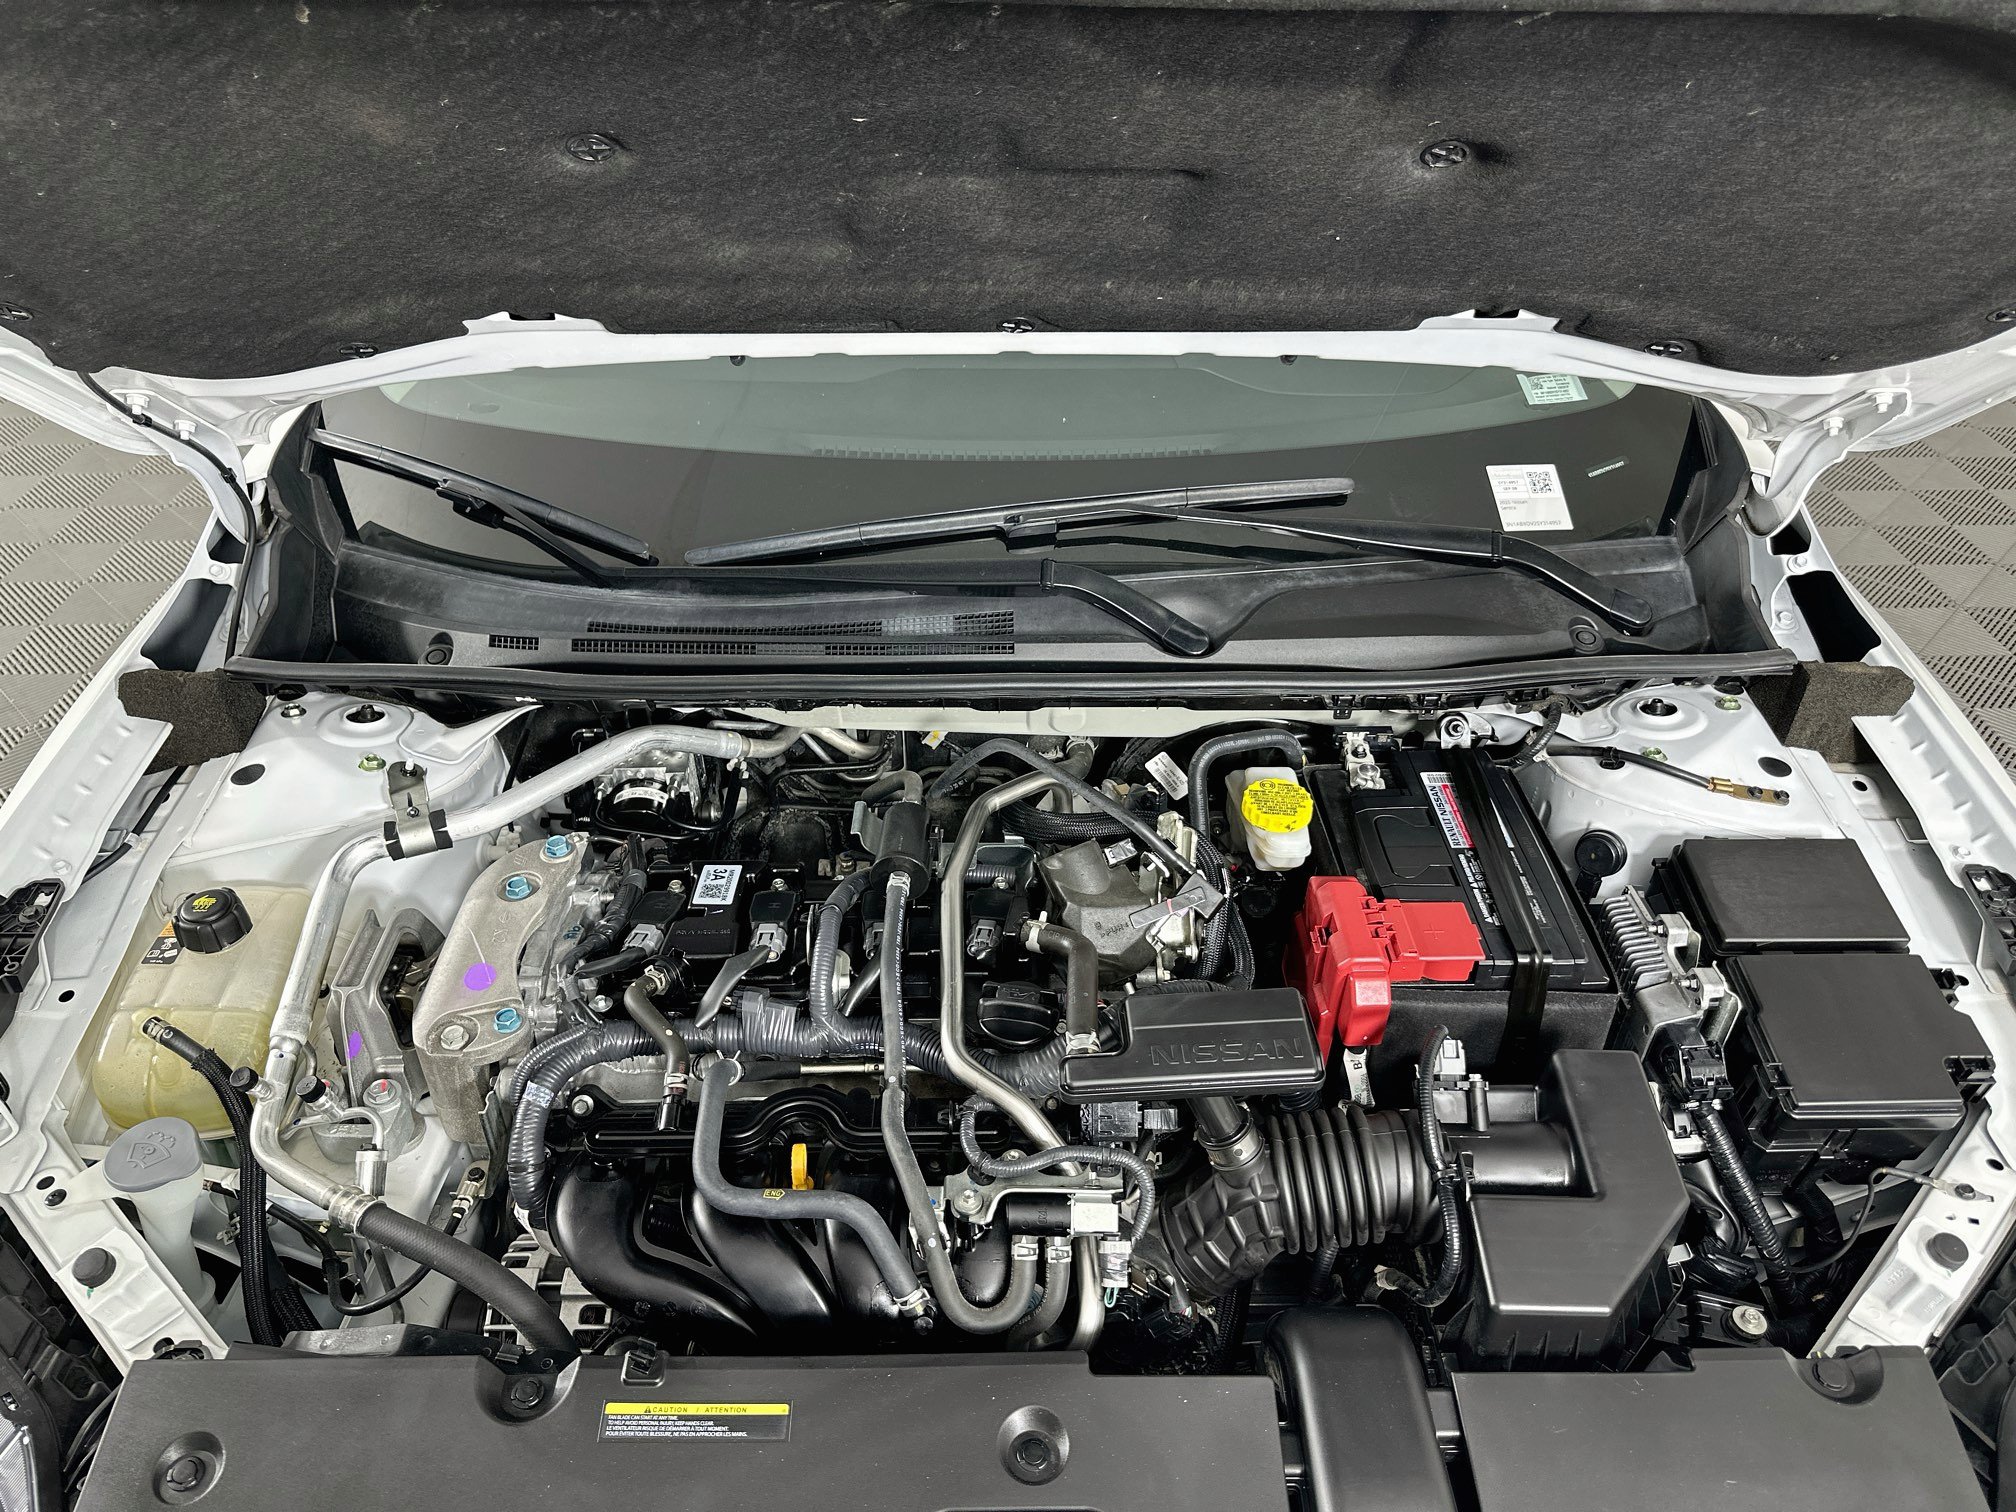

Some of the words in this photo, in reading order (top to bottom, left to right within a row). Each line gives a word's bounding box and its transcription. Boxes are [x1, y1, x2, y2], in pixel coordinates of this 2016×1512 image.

[1430, 785, 1448, 816] NISSAN
[1443, 816, 1462, 847] RENAULT
[710, 868, 728, 881] 3A
[1149, 1036, 1305, 1067] NISSAN
[765, 1189, 781, 1197] ENG
